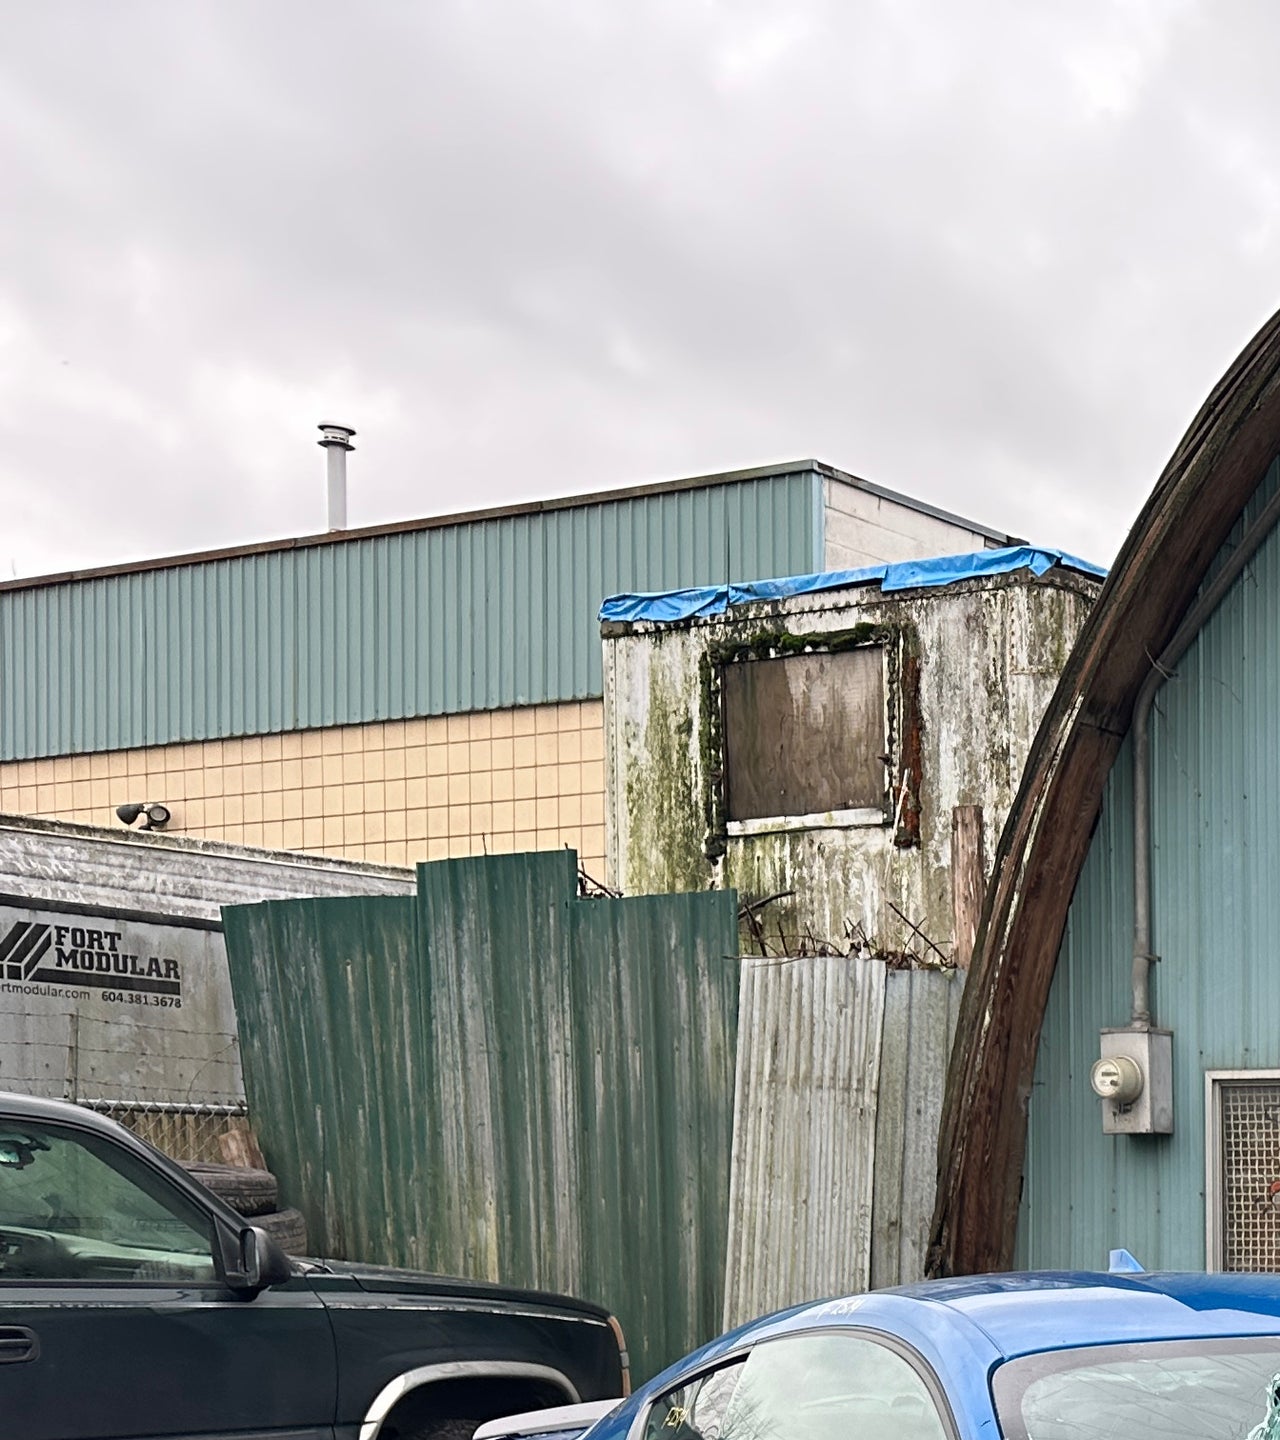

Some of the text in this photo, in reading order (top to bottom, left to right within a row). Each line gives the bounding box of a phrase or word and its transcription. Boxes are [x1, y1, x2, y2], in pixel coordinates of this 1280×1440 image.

[54, 925, 122, 952] FORT
[55, 947, 181, 979] MODULAR
[101, 991, 182, 1008] 604.381.3678
